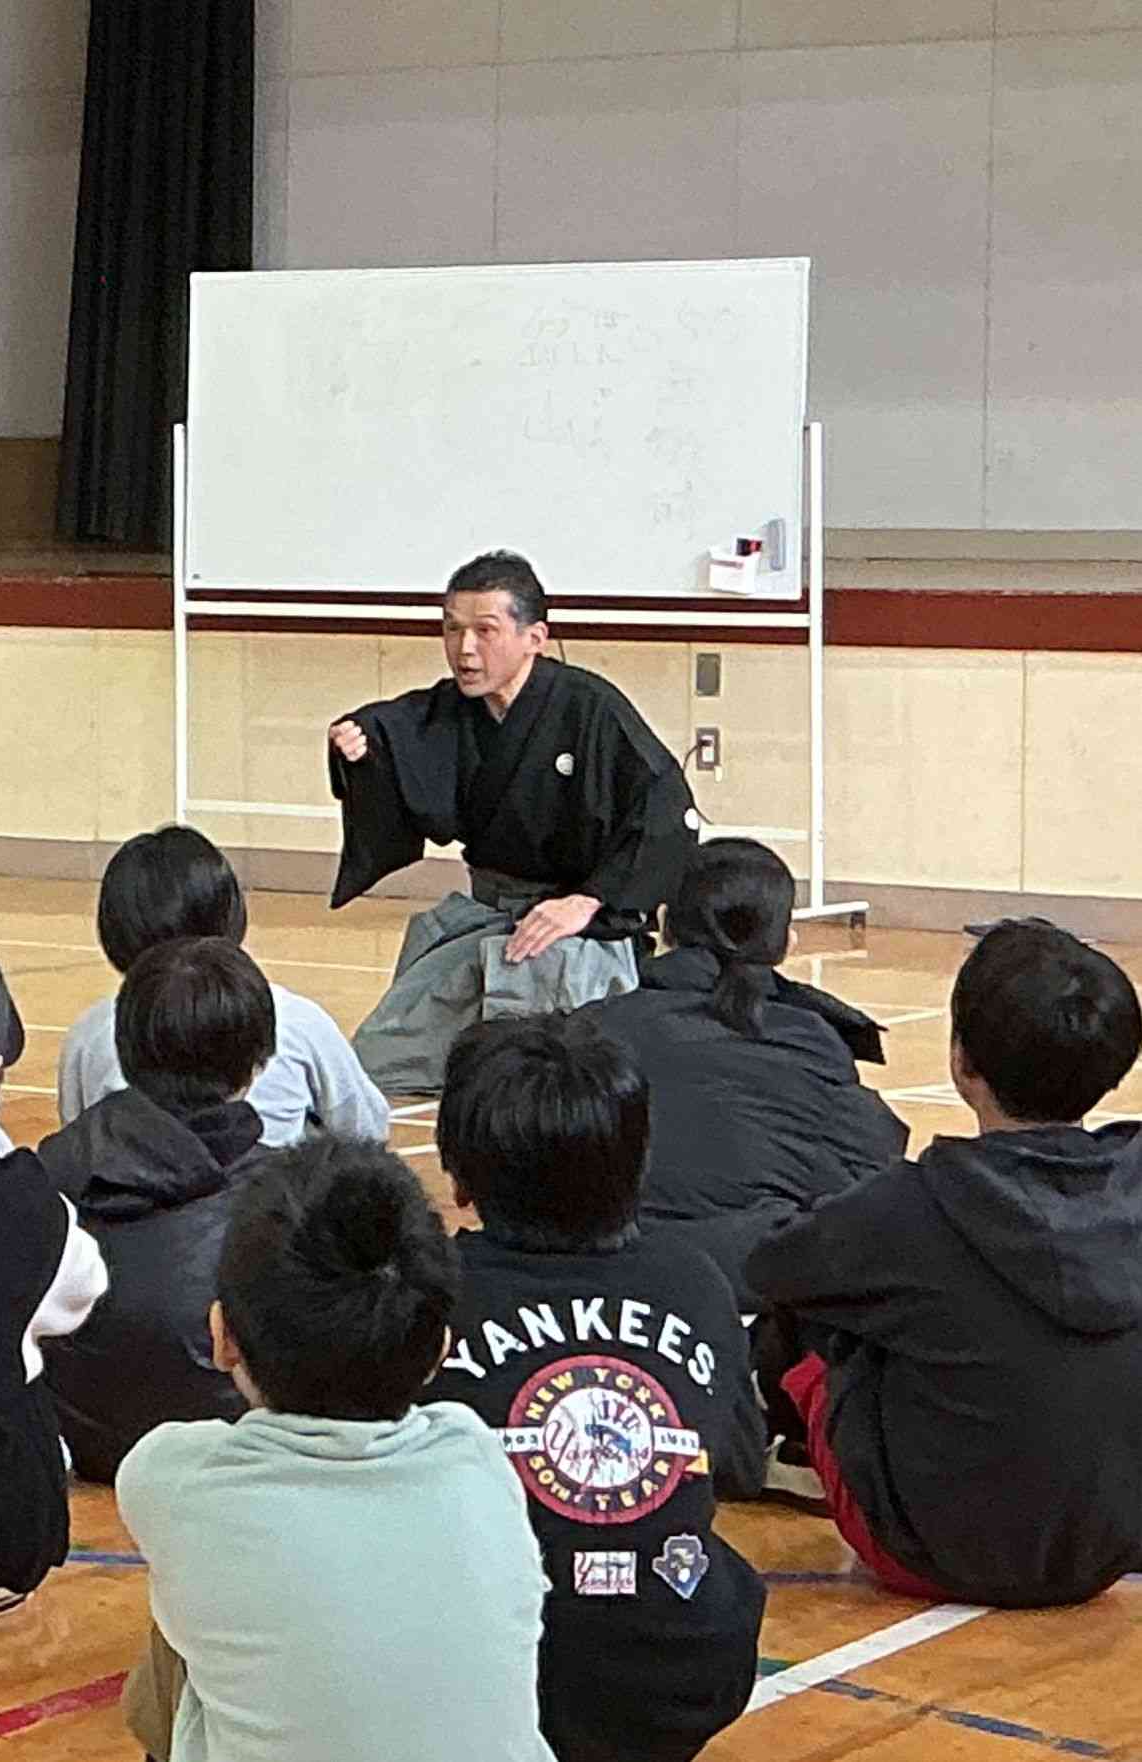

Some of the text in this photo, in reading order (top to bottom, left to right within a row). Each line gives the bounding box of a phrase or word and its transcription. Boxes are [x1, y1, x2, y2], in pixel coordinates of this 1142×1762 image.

[442, 1297, 715, 1387] YANKEES
[525, 1368, 668, 1421] NEW YORK
[596, 1458, 671, 1511] YEAR
